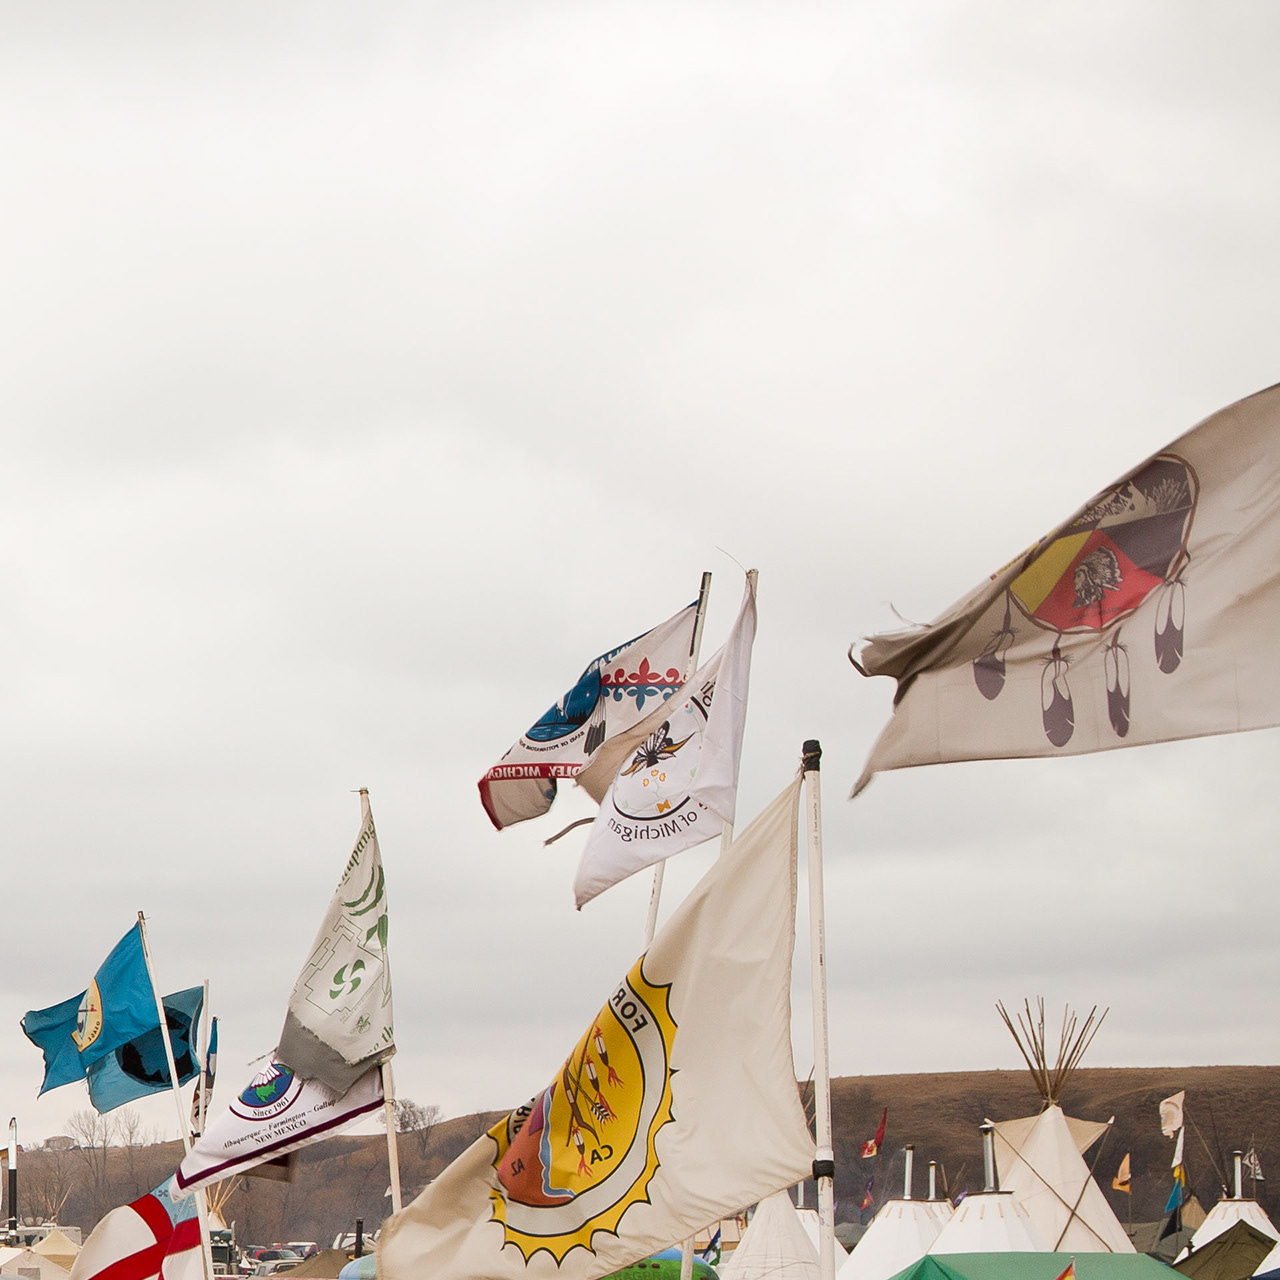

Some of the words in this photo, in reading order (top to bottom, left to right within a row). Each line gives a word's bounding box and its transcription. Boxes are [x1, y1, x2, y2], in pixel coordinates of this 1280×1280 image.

[252, 1108, 272, 1117] Since
[273, 1097, 290, 1111] 1961
[223, 1130, 261, 1149] Albuquerque
[268, 1112, 306, 1131] Farmington
[313, 1099, 337, 1113] Gallup
[255, 1132, 273, 1145] NEW
[274, 1120, 307, 1137] MEXICO
